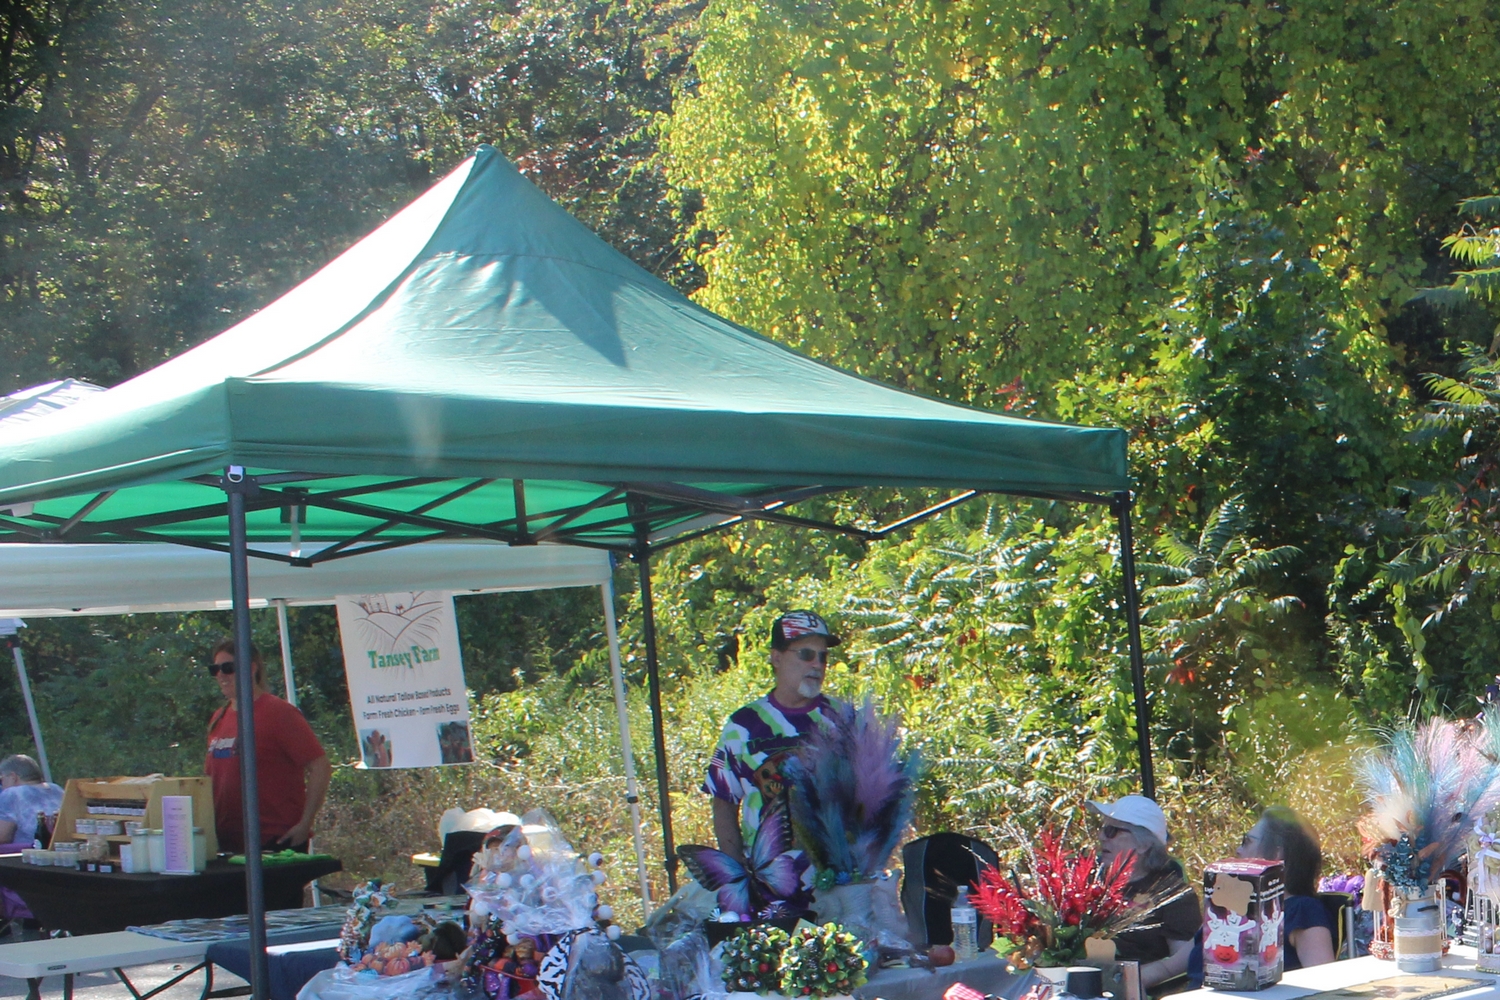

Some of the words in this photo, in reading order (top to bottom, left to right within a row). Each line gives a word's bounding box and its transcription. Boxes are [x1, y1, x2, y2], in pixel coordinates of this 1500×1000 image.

[367, 650, 414, 669] Tansey
[411, 645, 440, 664] Farm
[367, 695, 375, 703] All
[375, 692, 397, 703] Natural
[398, 691, 414, 701] Tallow
[363, 711, 378, 720] Farm
[378, 709, 394, 719] Fresh
[394, 708, 416, 718] Chicken
[430, 704, 446, 714] Fresh
[446, 703, 460, 715] Eggs
